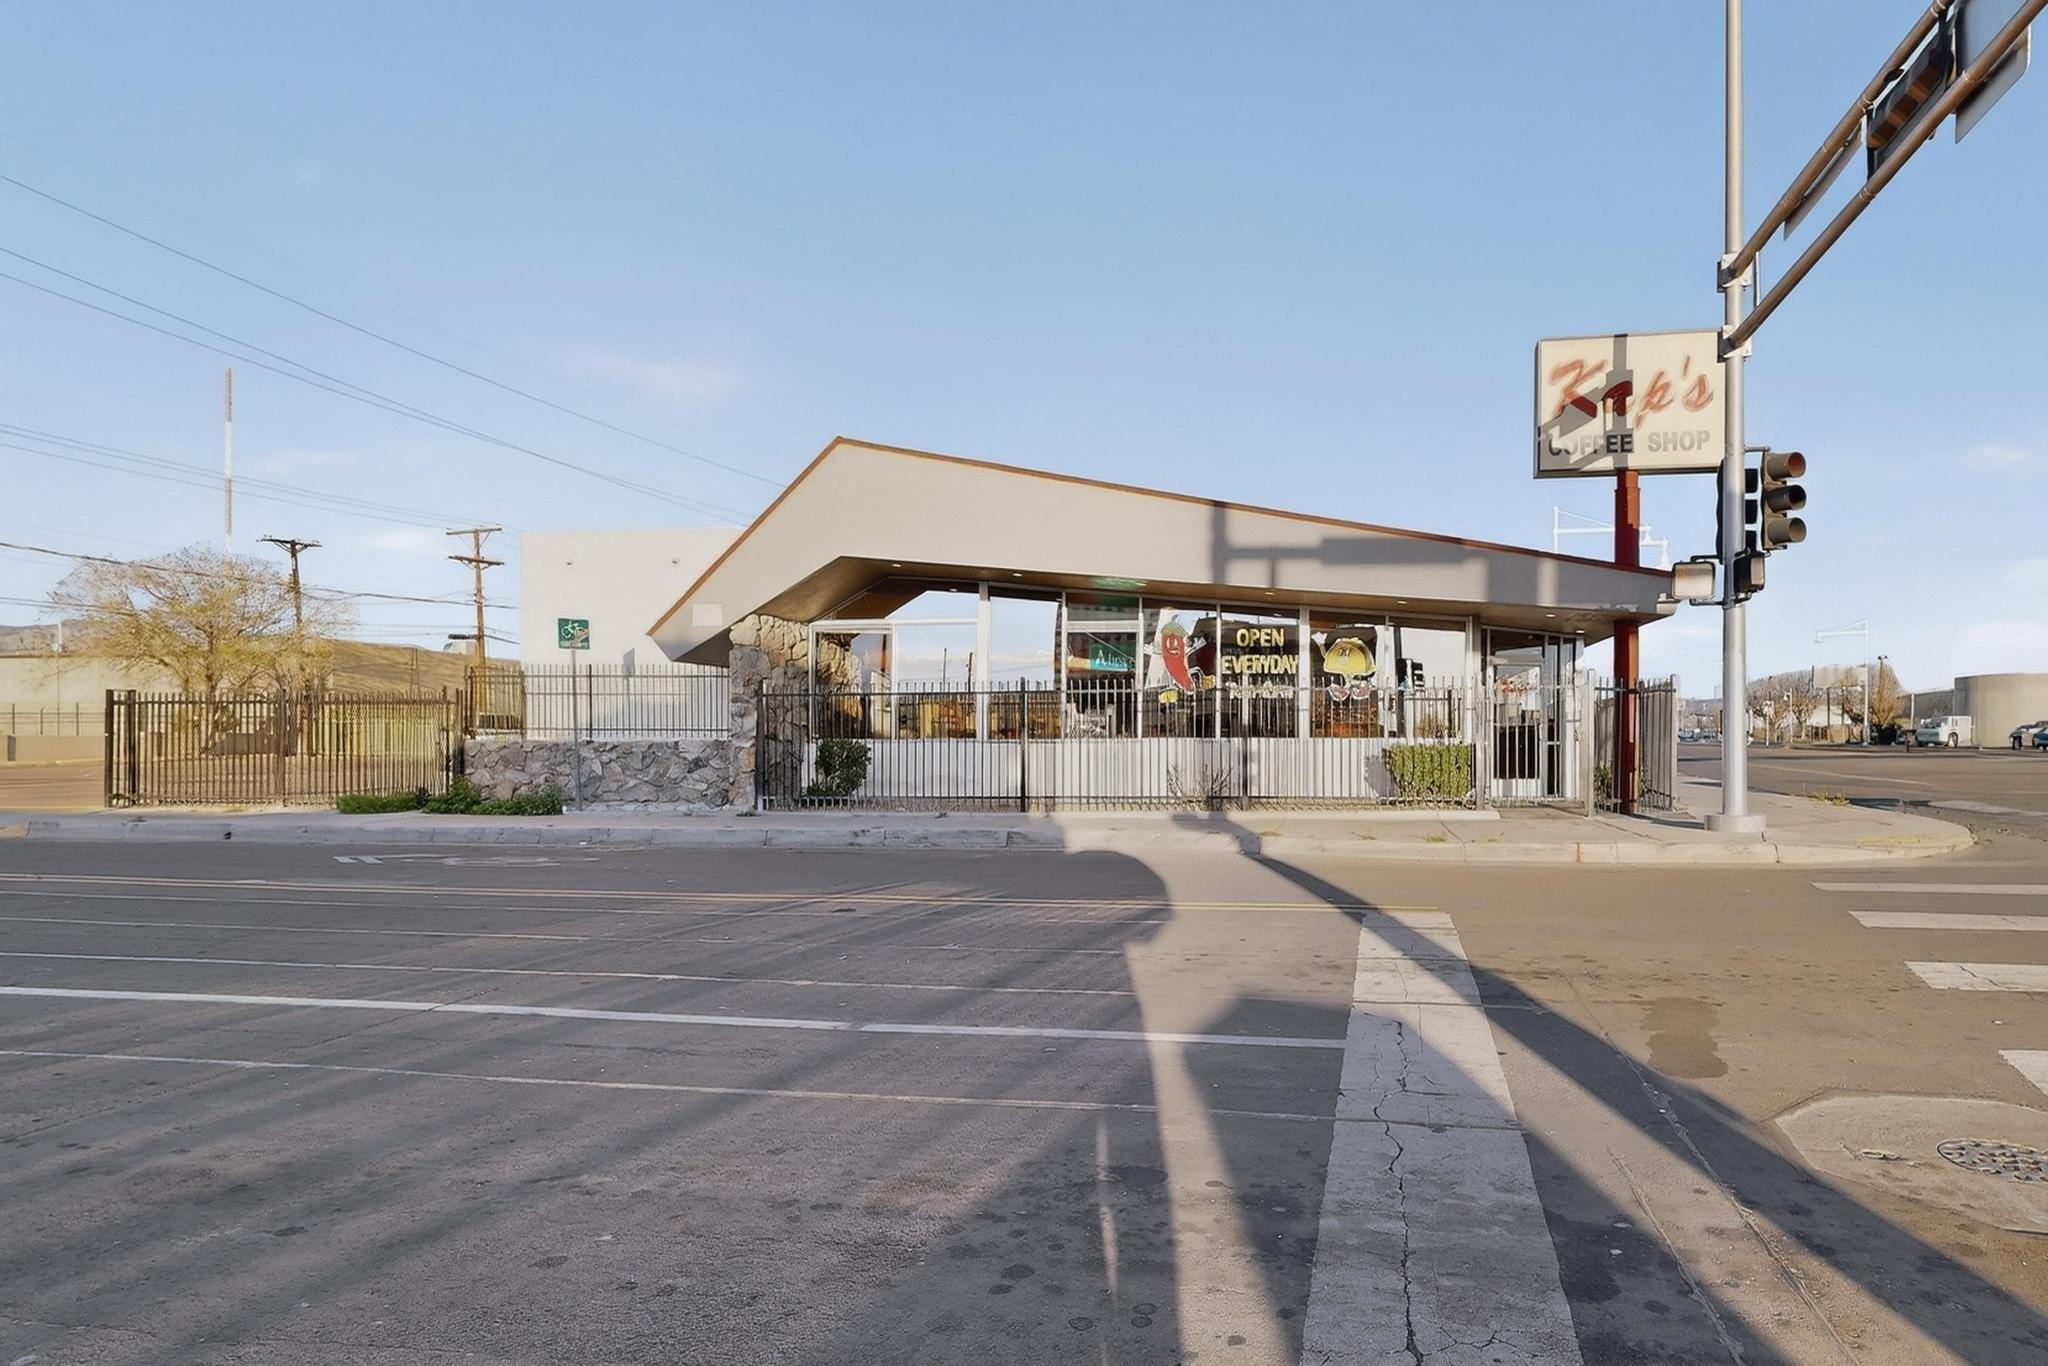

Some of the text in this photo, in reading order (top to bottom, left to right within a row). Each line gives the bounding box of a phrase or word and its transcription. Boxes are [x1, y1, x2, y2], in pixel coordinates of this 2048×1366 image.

[1548, 431, 1711, 456] COFFEE SHOP
[1236, 628, 1285, 646] OPEN
[1221, 654, 1299, 674] EVERYDAY
